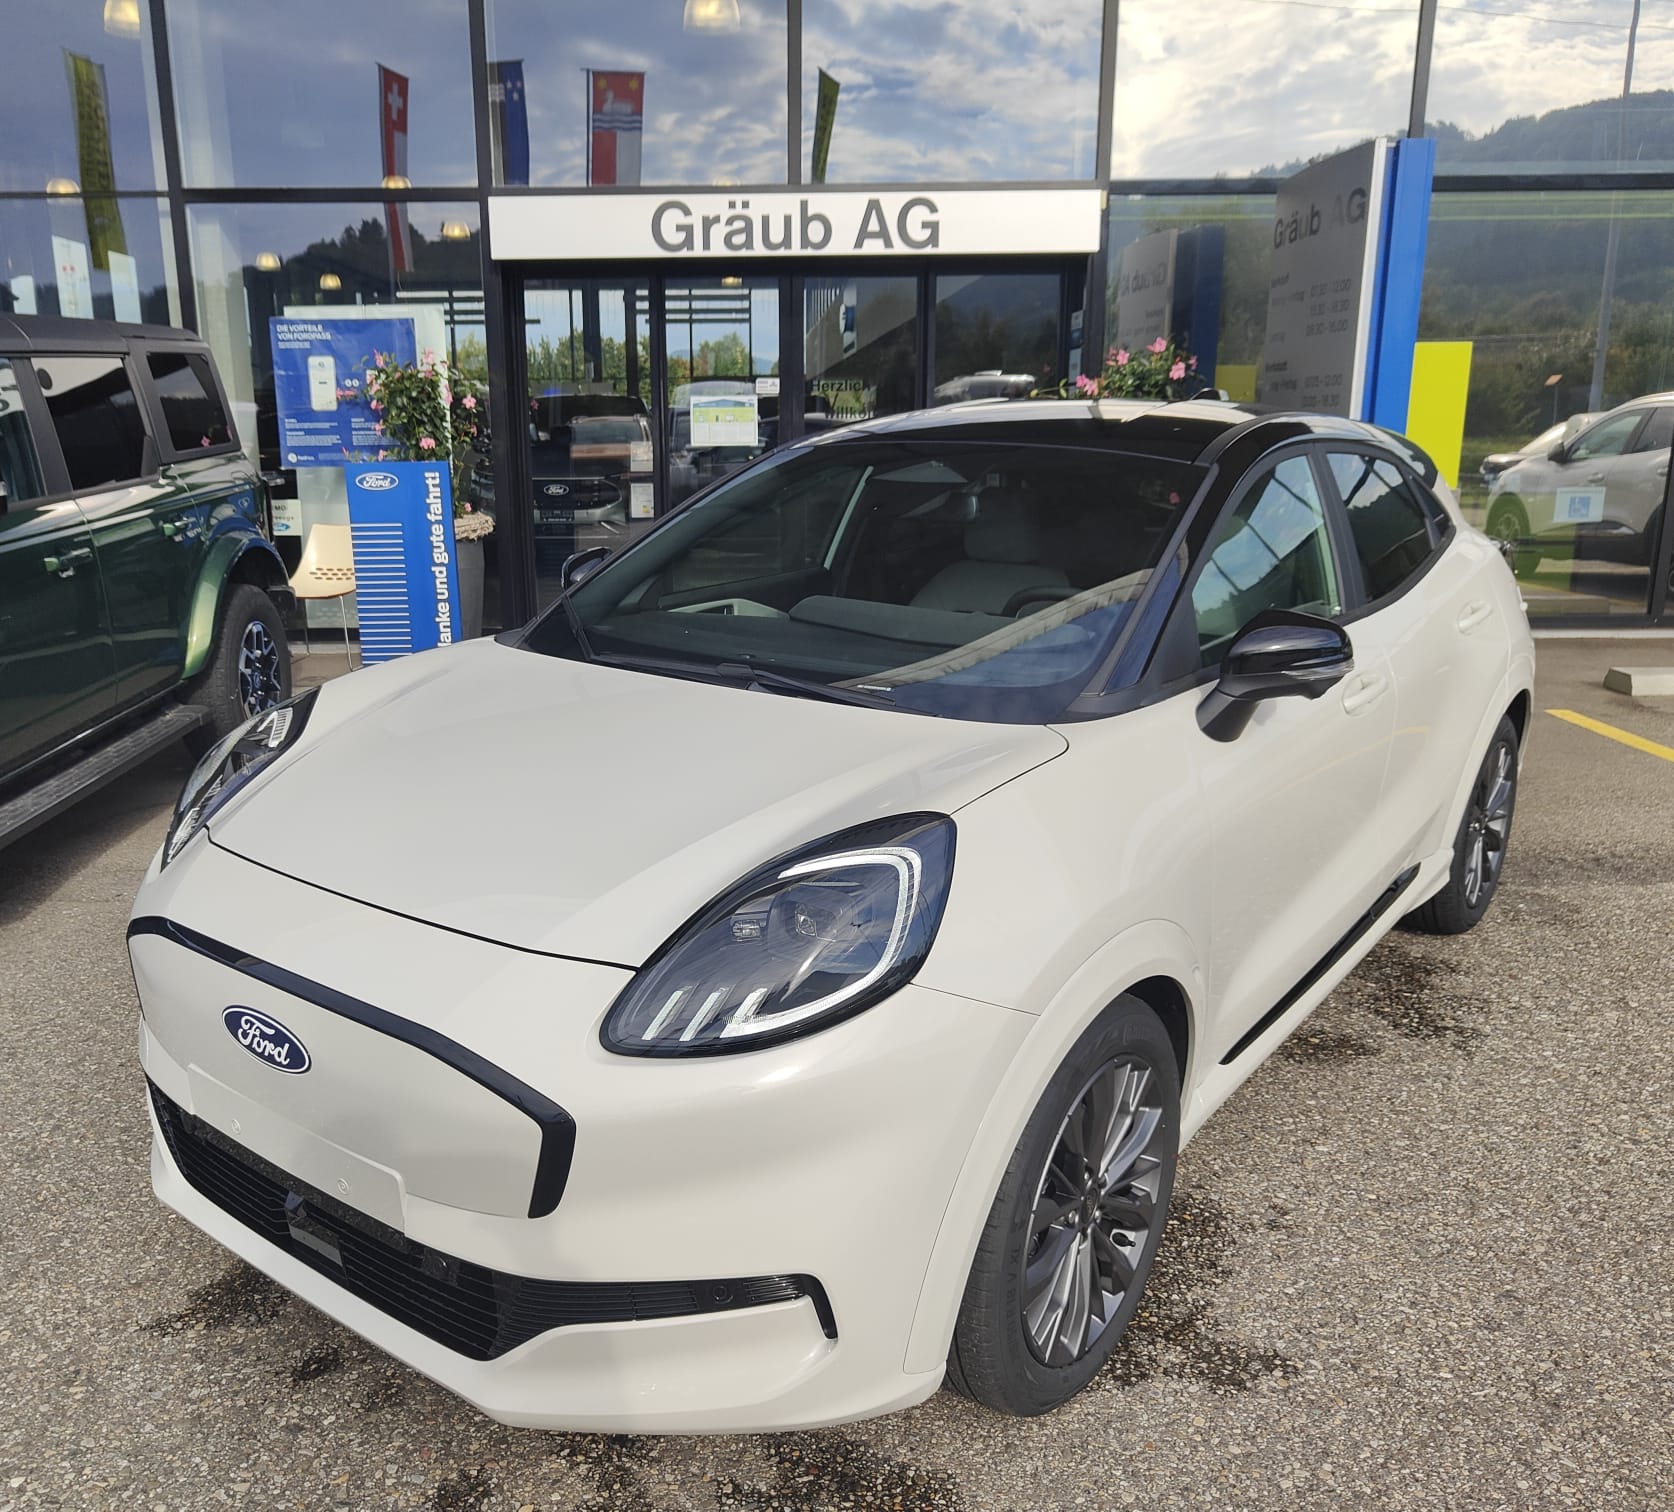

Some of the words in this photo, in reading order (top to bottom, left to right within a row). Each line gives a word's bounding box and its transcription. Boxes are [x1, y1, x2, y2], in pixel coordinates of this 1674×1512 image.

[651, 200, 832, 251] Gräub
[853, 197, 940, 249] AG
[1274, 203, 1321, 249] Gräub
[424, 472, 443, 522] fahrt!
[429, 524, 449, 564] gute
[432, 566, 449, 600] und
[436, 601, 452, 648] anke
[237, 1015, 291, 1066] Ford
